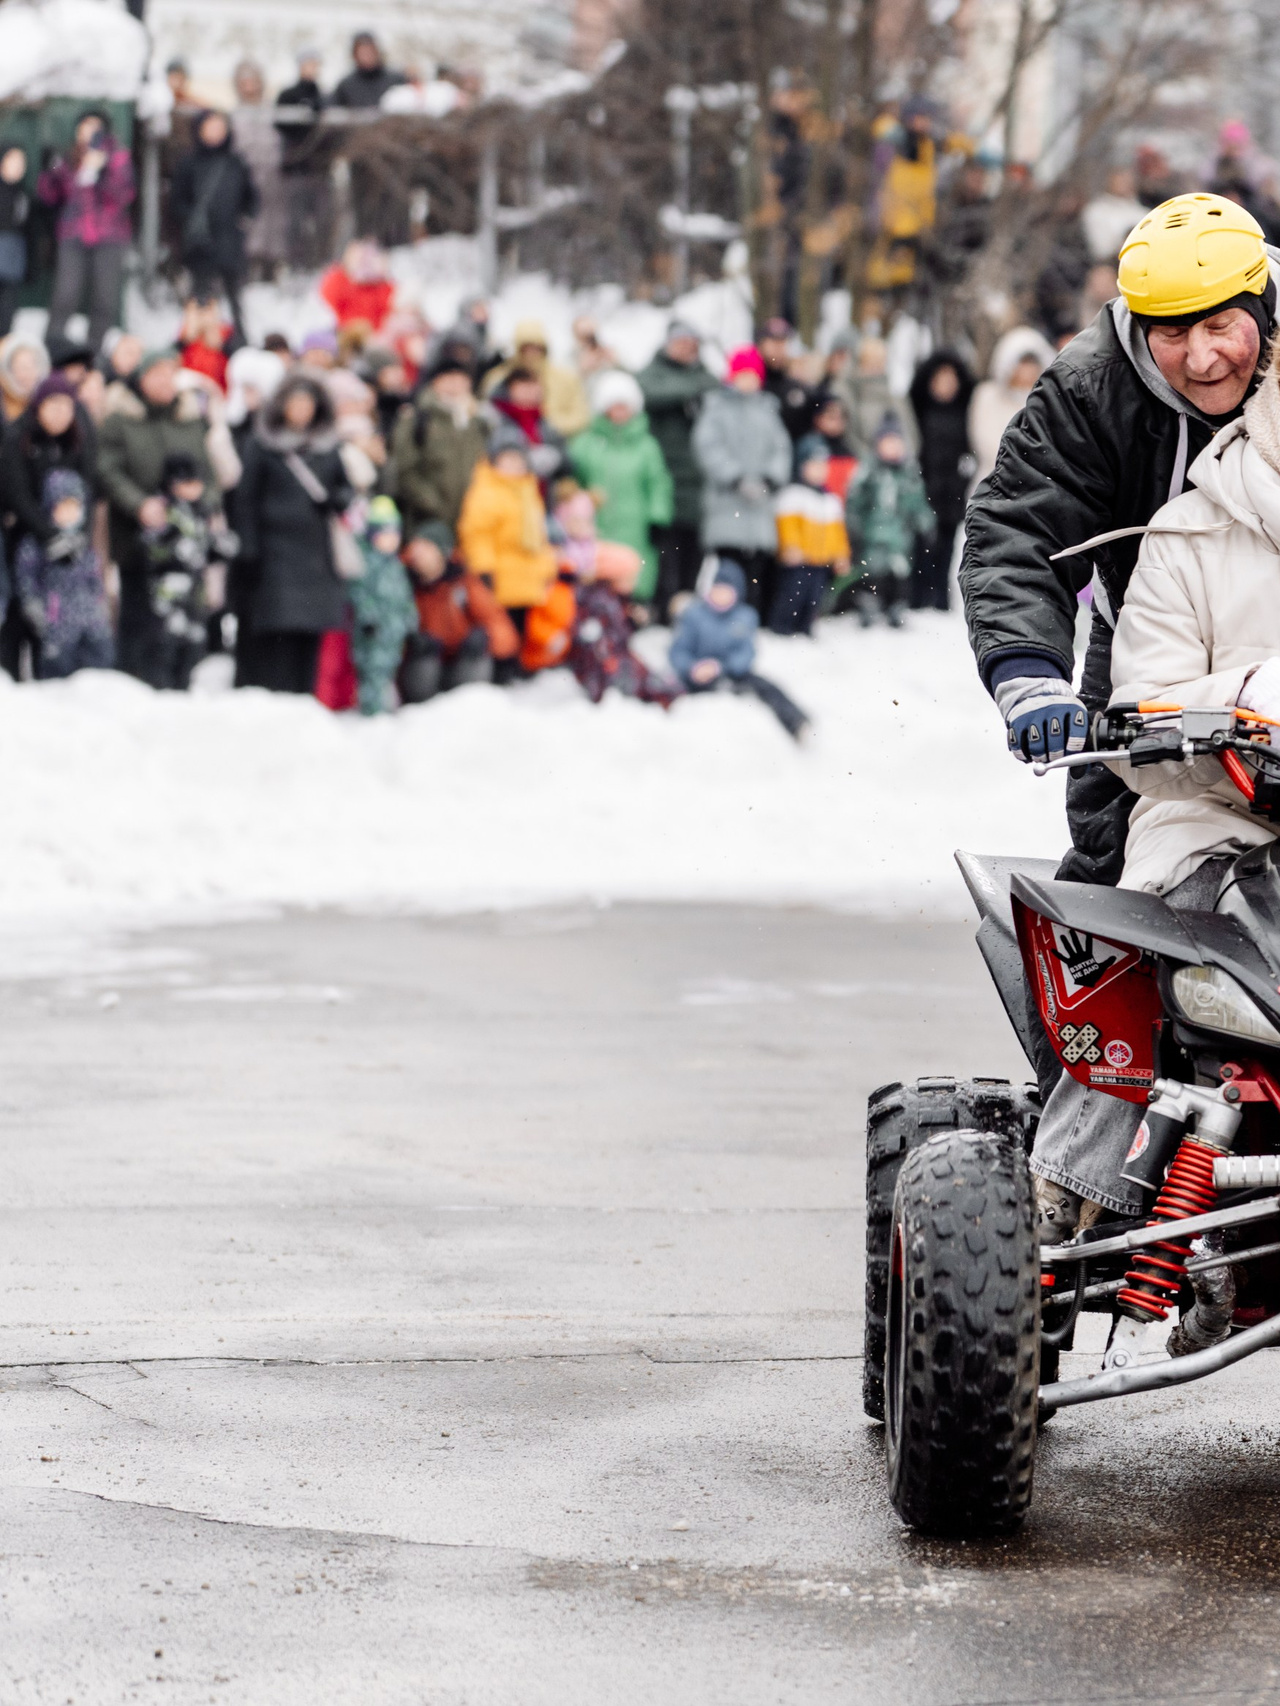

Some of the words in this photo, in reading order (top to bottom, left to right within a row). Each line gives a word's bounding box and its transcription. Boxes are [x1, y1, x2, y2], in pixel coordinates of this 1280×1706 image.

[1070, 958, 1096, 973] ВЗЯТКИ
[1073, 971, 1083, 980] НЕ
[1083, 964, 1099, 976] ДАЮ
[1090, 1075, 1117, 1083] YAMAHA
[1124, 1069, 1153, 1078] RACING
